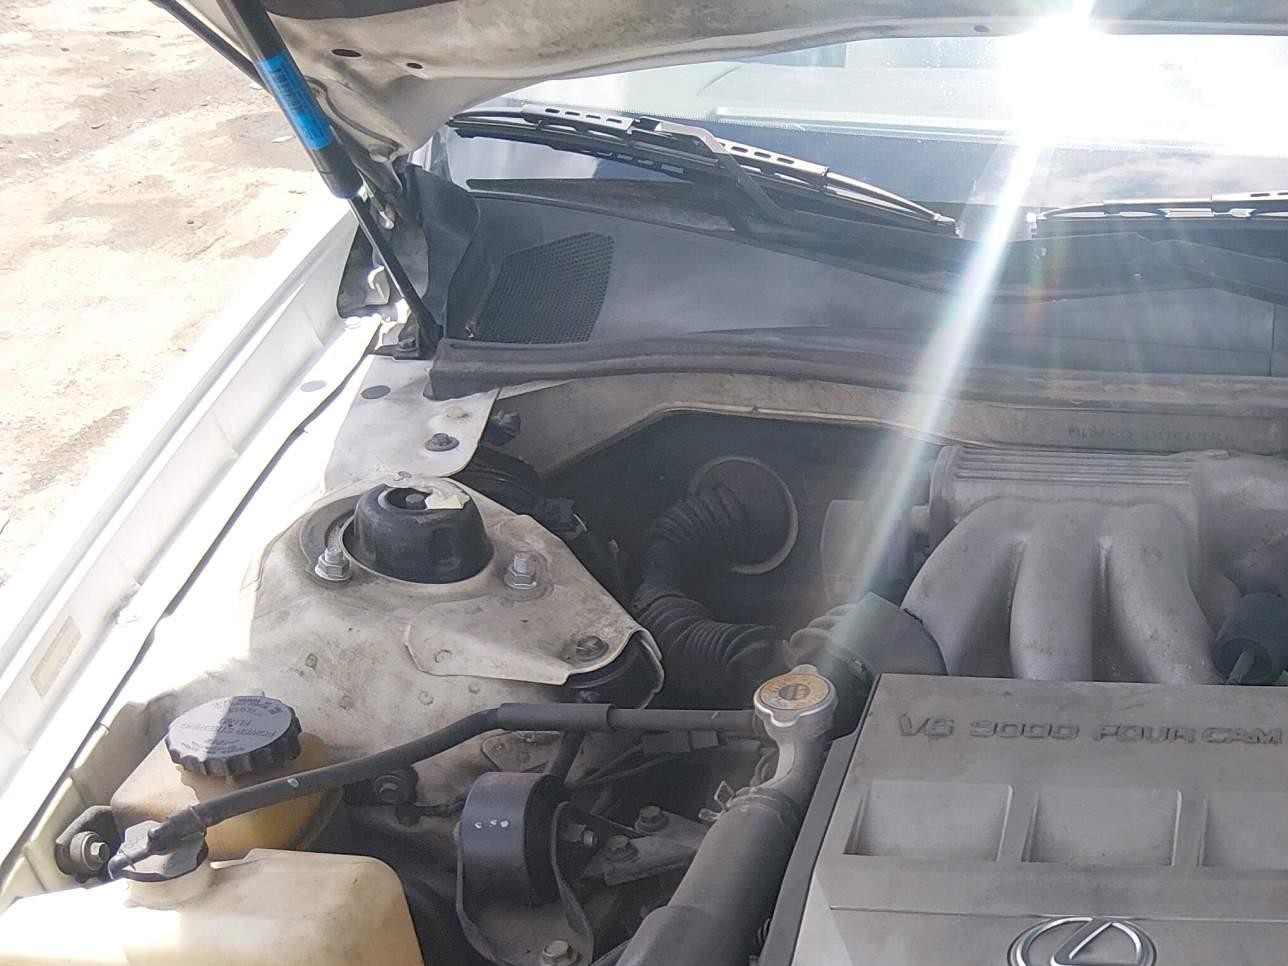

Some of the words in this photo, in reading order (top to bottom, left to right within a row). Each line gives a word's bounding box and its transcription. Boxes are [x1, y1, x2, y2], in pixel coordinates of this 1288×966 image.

[899, 713, 954, 737] V6
[1093, 725, 1197, 744] FOUR
[1201, 727, 1283, 745] CAM
